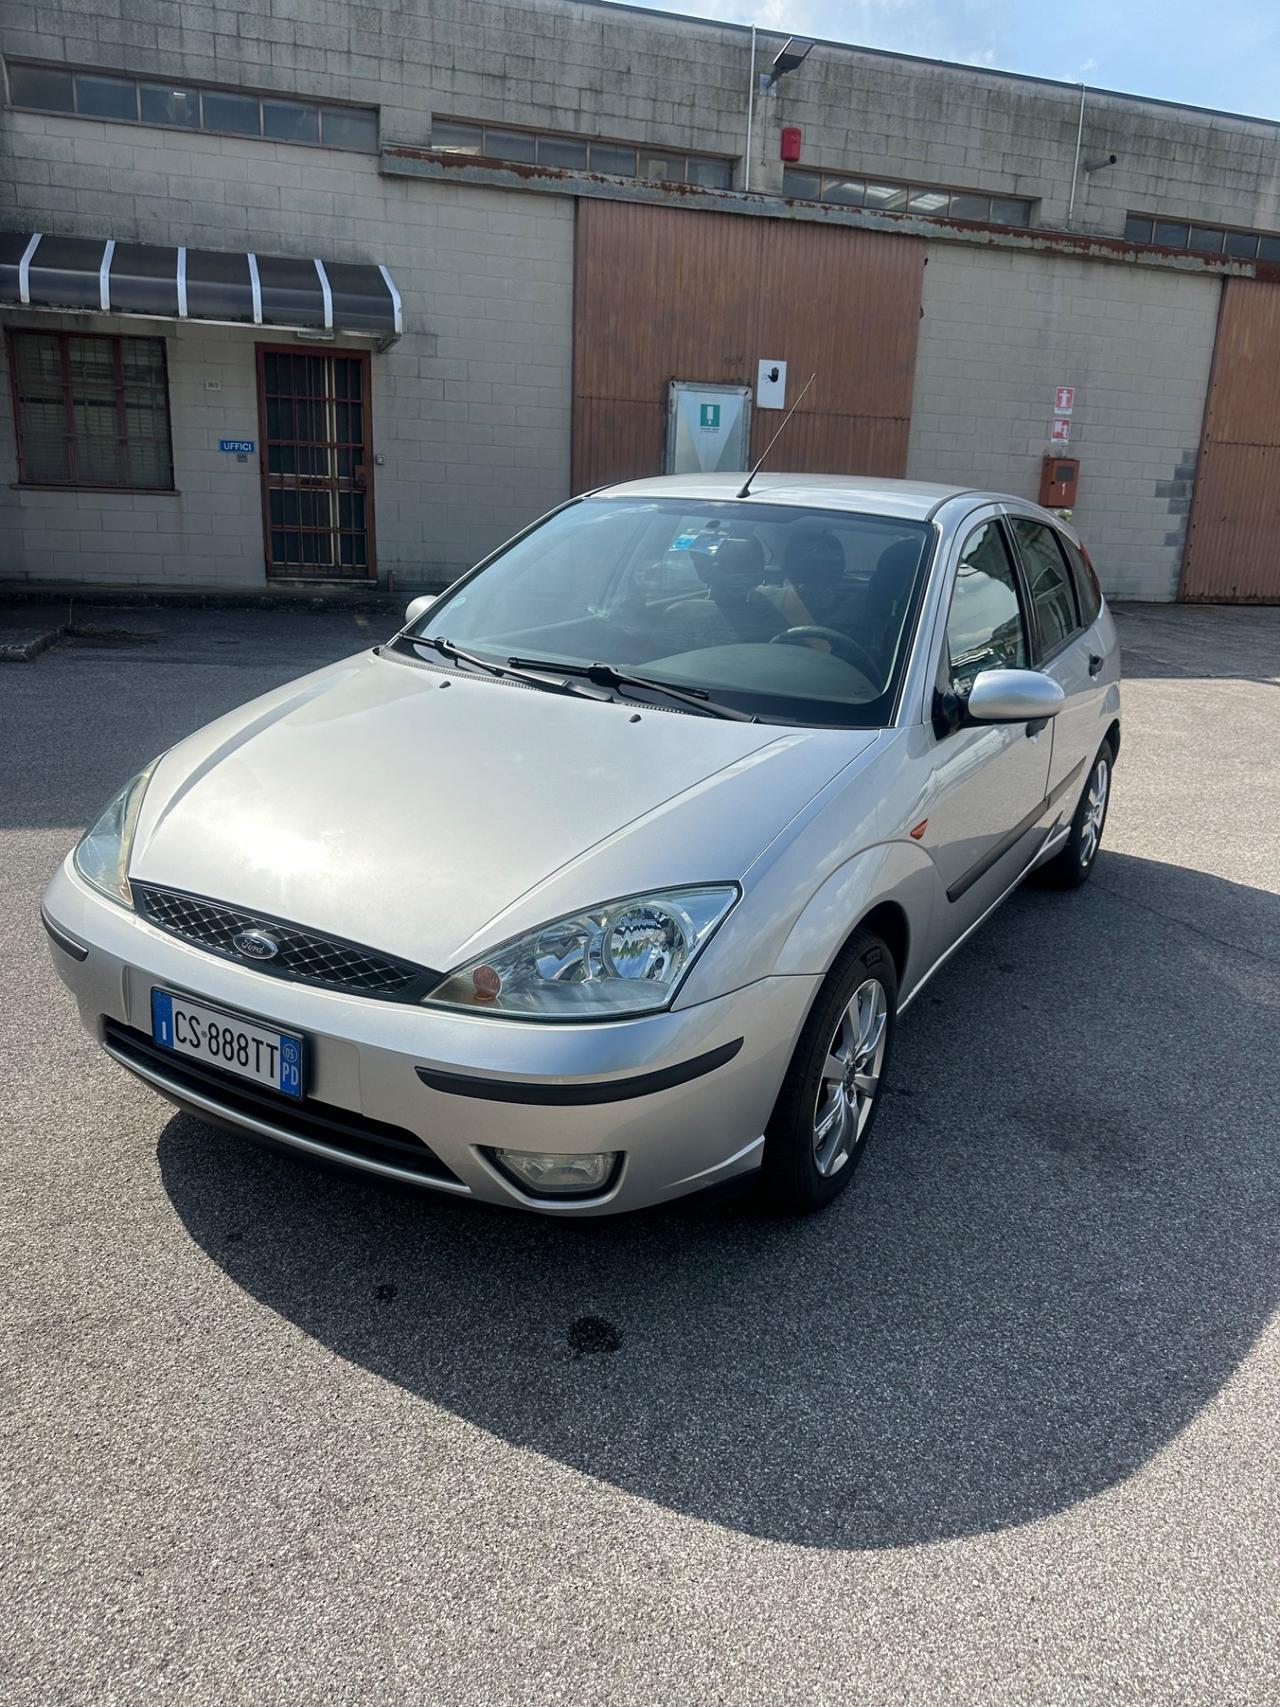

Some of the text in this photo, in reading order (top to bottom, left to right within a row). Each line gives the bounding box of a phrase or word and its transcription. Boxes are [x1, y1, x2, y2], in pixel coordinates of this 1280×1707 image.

[223, 442, 252, 451] UFFICI
[241, 937, 265, 954] Ford
[282, 1061, 299, 1086] PD
